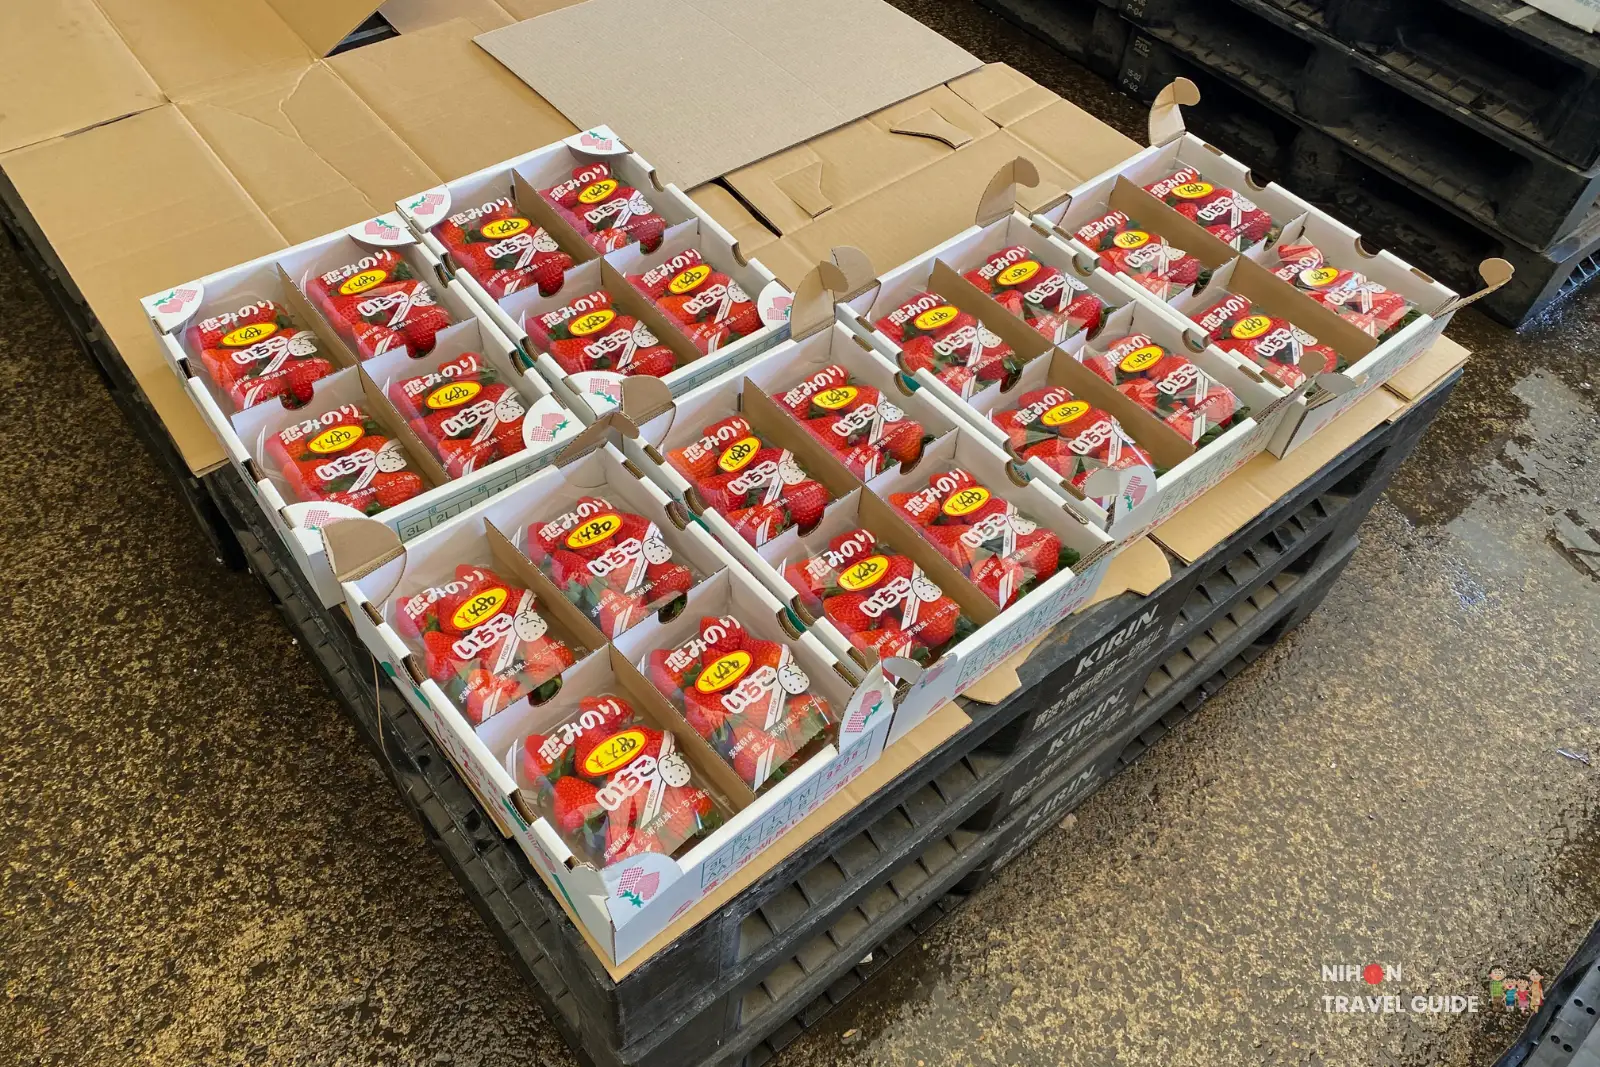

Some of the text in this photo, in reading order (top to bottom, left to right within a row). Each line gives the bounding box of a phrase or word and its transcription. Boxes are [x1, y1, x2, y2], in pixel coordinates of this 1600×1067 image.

[549, 164, 608, 201] 恋みのり
[1150, 167, 1200, 198] 恋みのり
[448, 197, 512, 228] 恋みのり
[584, 198, 628, 223] いちご
[1078, 210, 1129, 241] 恋みのり
[1197, 196, 1233, 221] いちご
[485, 233, 533, 259] いちご
[978, 245, 1034, 280] 恋みのり
[1124, 243, 1163, 268] いちご
[321, 249, 392, 285] 恋みのり
[642, 248, 702, 288] 恋みのり
[357, 291, 409, 317] いちご
[682, 284, 727, 315] いちご
[1023, 274, 1066, 304] いちご
[199, 300, 274, 334] 恋みのり
[541, 291, 607, 329] 恋みのり
[887, 293, 947, 327] 恋みのり
[1200, 293, 1252, 331] 恋みのり
[231, 336, 289, 364] いちご
[583, 328, 632, 359] いちご
[932, 325, 978, 356] いちご
[1254, 328, 1293, 357] いちご
[403, 355, 477, 398] 恋みのり
[783, 365, 844, 408] 恋みのり
[1156, 363, 1198, 395] いちご
[279, 403, 359, 445] 恋みのり
[440, 399, 495, 437] いちご
[831, 403, 877, 437] いちご
[1013, 386, 1074, 426] 恋みのり
[682, 418, 750, 463] 恋みのり
[1067, 420, 1113, 455] いちご
[315, 448, 376, 480] いちご
[727, 460, 778, 495] いちご
[903, 467, 970, 517] 恋みのり
[406, 525, 425, 538] 3L
[436, 511, 454, 525] 2L
[538, 498, 613, 542] 恋みのり
[959, 512, 1008, 548] いちご
[586, 537, 643, 577] いちご
[804, 528, 875, 581] 恋みのり
[403, 570, 485, 620] 恋みのり
[858, 576, 911, 618] いちご
[452, 612, 513, 660] いちご
[664, 614, 741, 673] 恋みのり
[1074, 604, 1159, 676] KIRIN
[720, 665, 777, 714] いちご
[537, 699, 621, 765] 恋みのり
[1049, 687, 1124, 755] KIRIN
[595, 754, 657, 811] いちご
[1026, 765, 1095, 828] KIRIN
